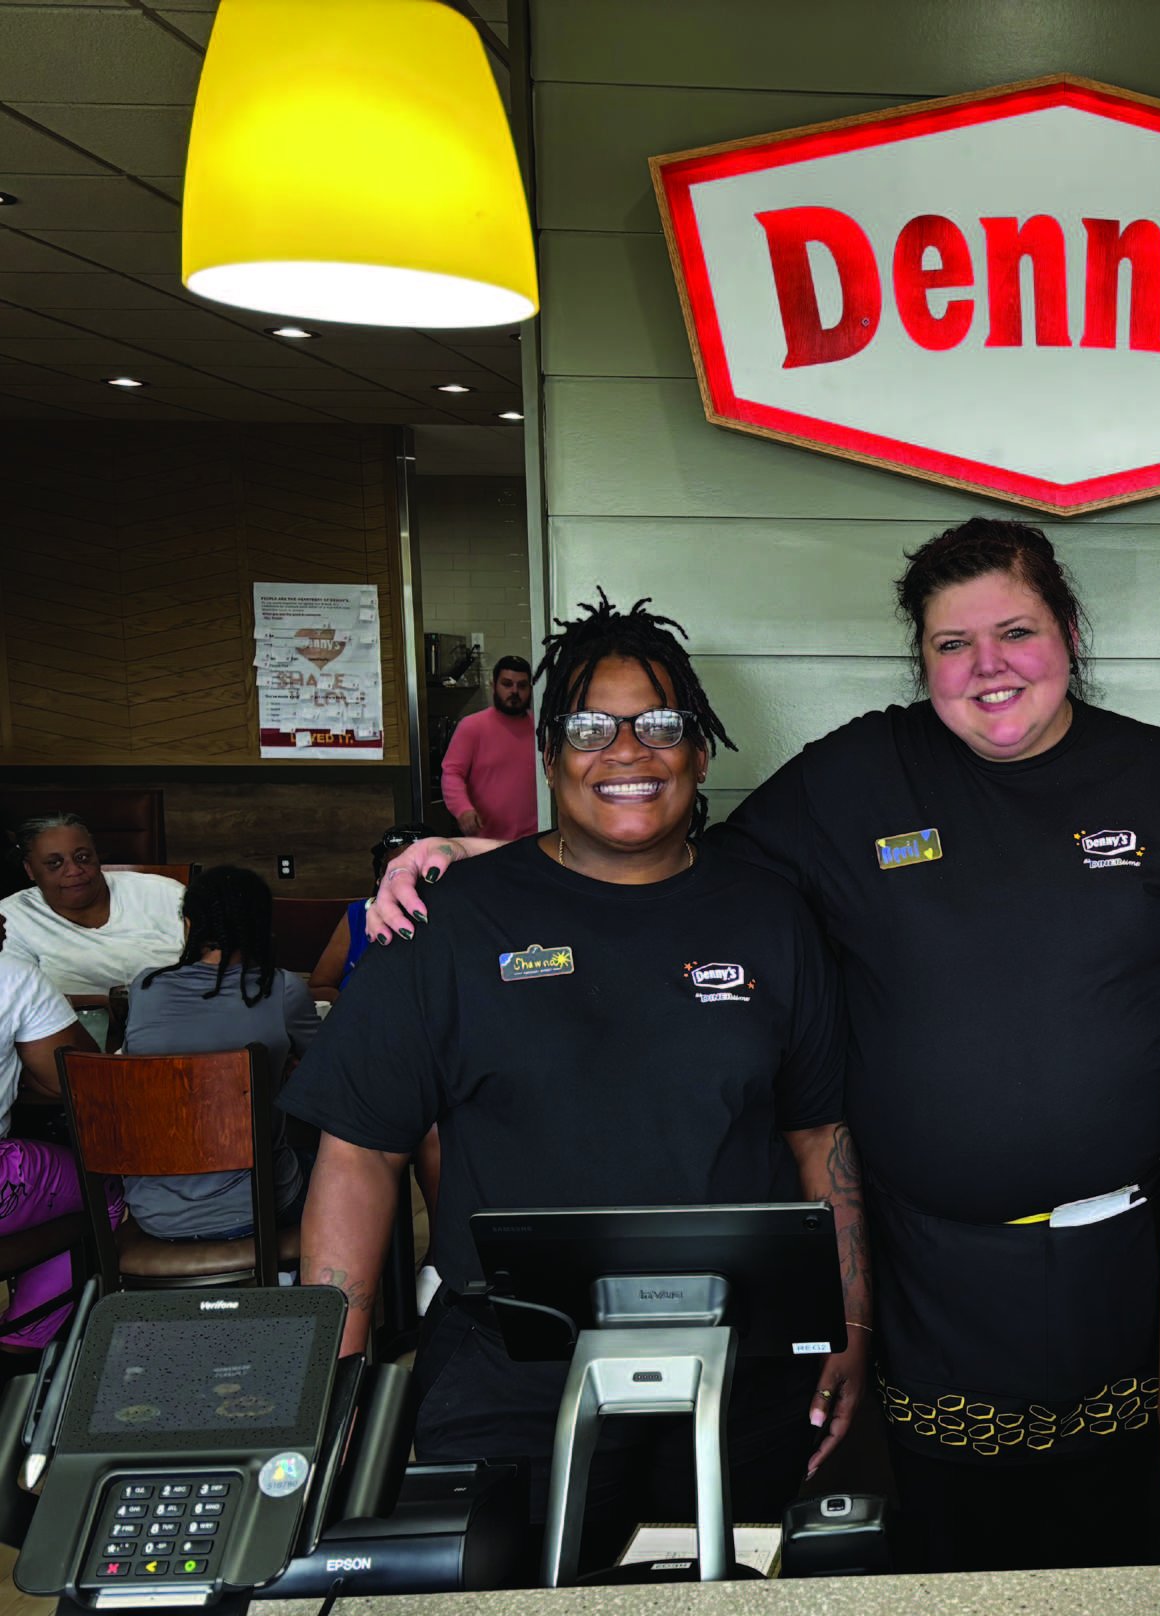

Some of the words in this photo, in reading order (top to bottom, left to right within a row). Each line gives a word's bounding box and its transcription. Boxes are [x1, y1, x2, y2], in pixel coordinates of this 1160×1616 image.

[290, 733, 334, 743] LVED
[1085, 833, 1128, 850] Denny's
[695, 966, 737, 982] Denny's
[200, 1301, 239, 1311] Verifone
[126, 1486, 131, 1497] 1
[162, 1485, 171, 1496] 2
[200, 1484, 209, 1495] 3
[118, 1506, 126, 1516] 4
[156, 1504, 165, 1514] 5
[195, 1503, 203, 1514] 6
[113, 1524, 121, 1535] 7
[150, 1523, 159, 1534] 8
[189, 1522, 198, 1533] 9
[145, 1542, 154, 1553] 0
[327, 1557, 372, 1571] EPSON
